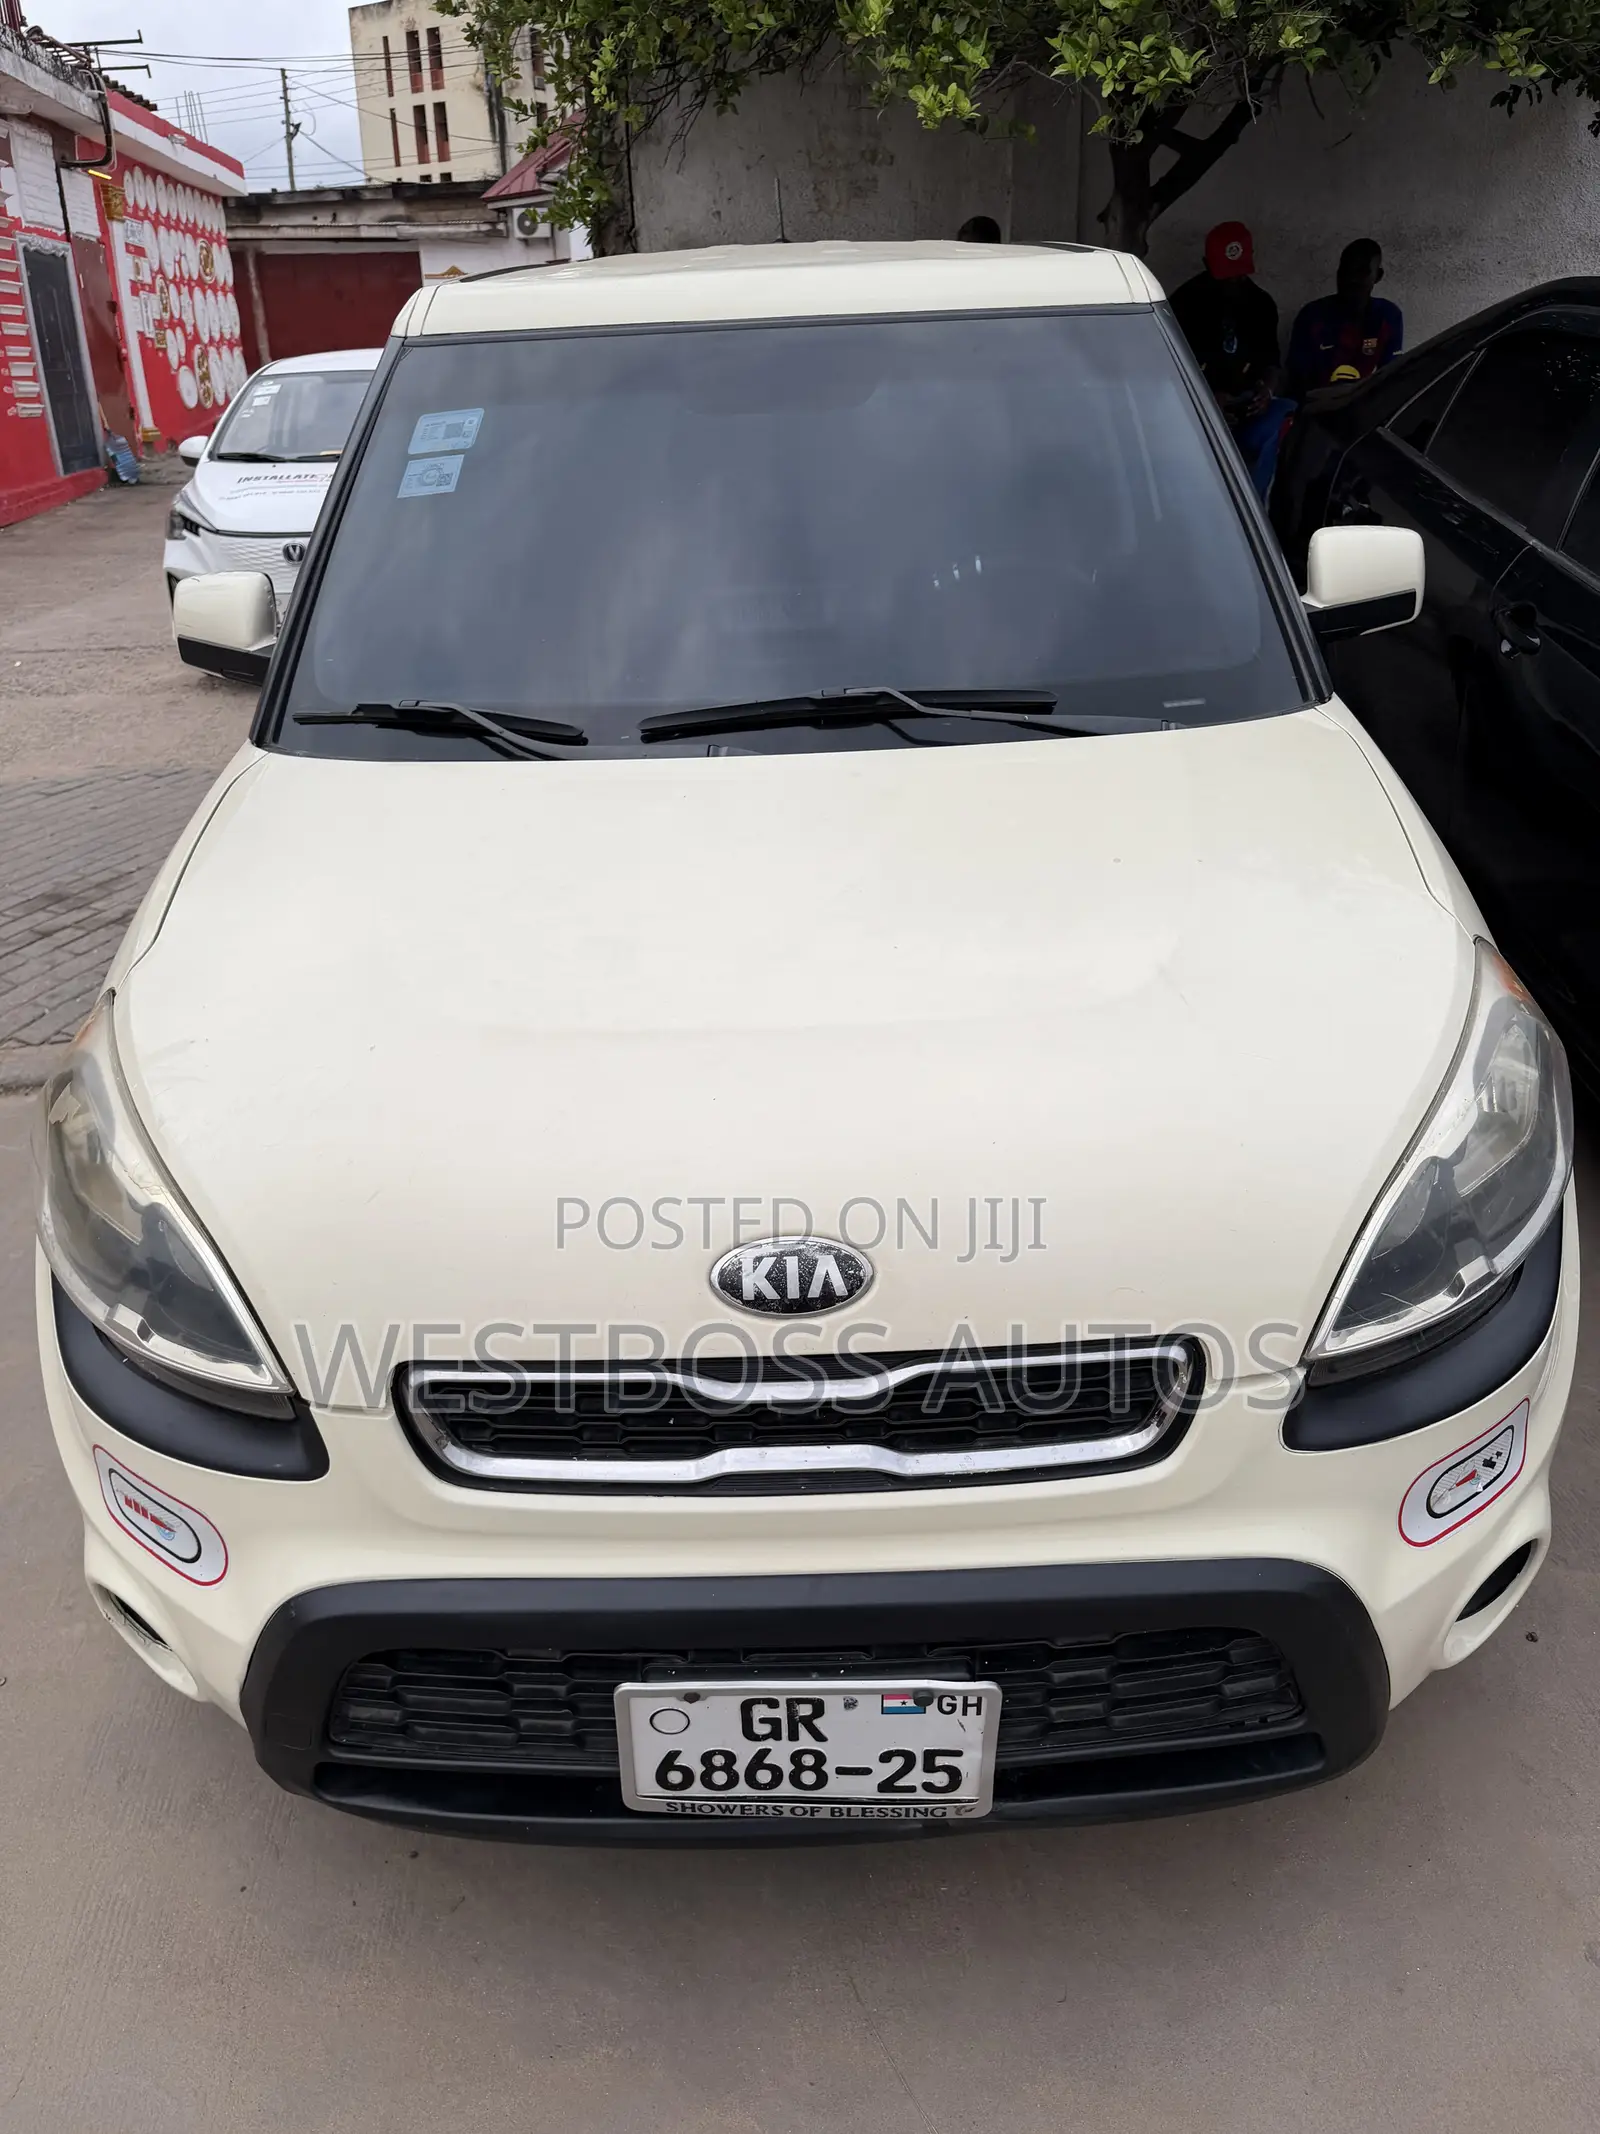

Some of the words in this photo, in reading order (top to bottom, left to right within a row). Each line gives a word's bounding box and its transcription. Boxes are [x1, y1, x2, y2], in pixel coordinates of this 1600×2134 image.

[740, 1255, 850, 1301] KIA
[740, 1696, 829, 1743] GR
[936, 1694, 983, 1717] GH
[654, 1747, 965, 1794] 6868-25
[665, 1801, 784, 1817] SHOWERS
[790, 1805, 823, 1818] OF
[829, 1805, 948, 1818] BLESSING
